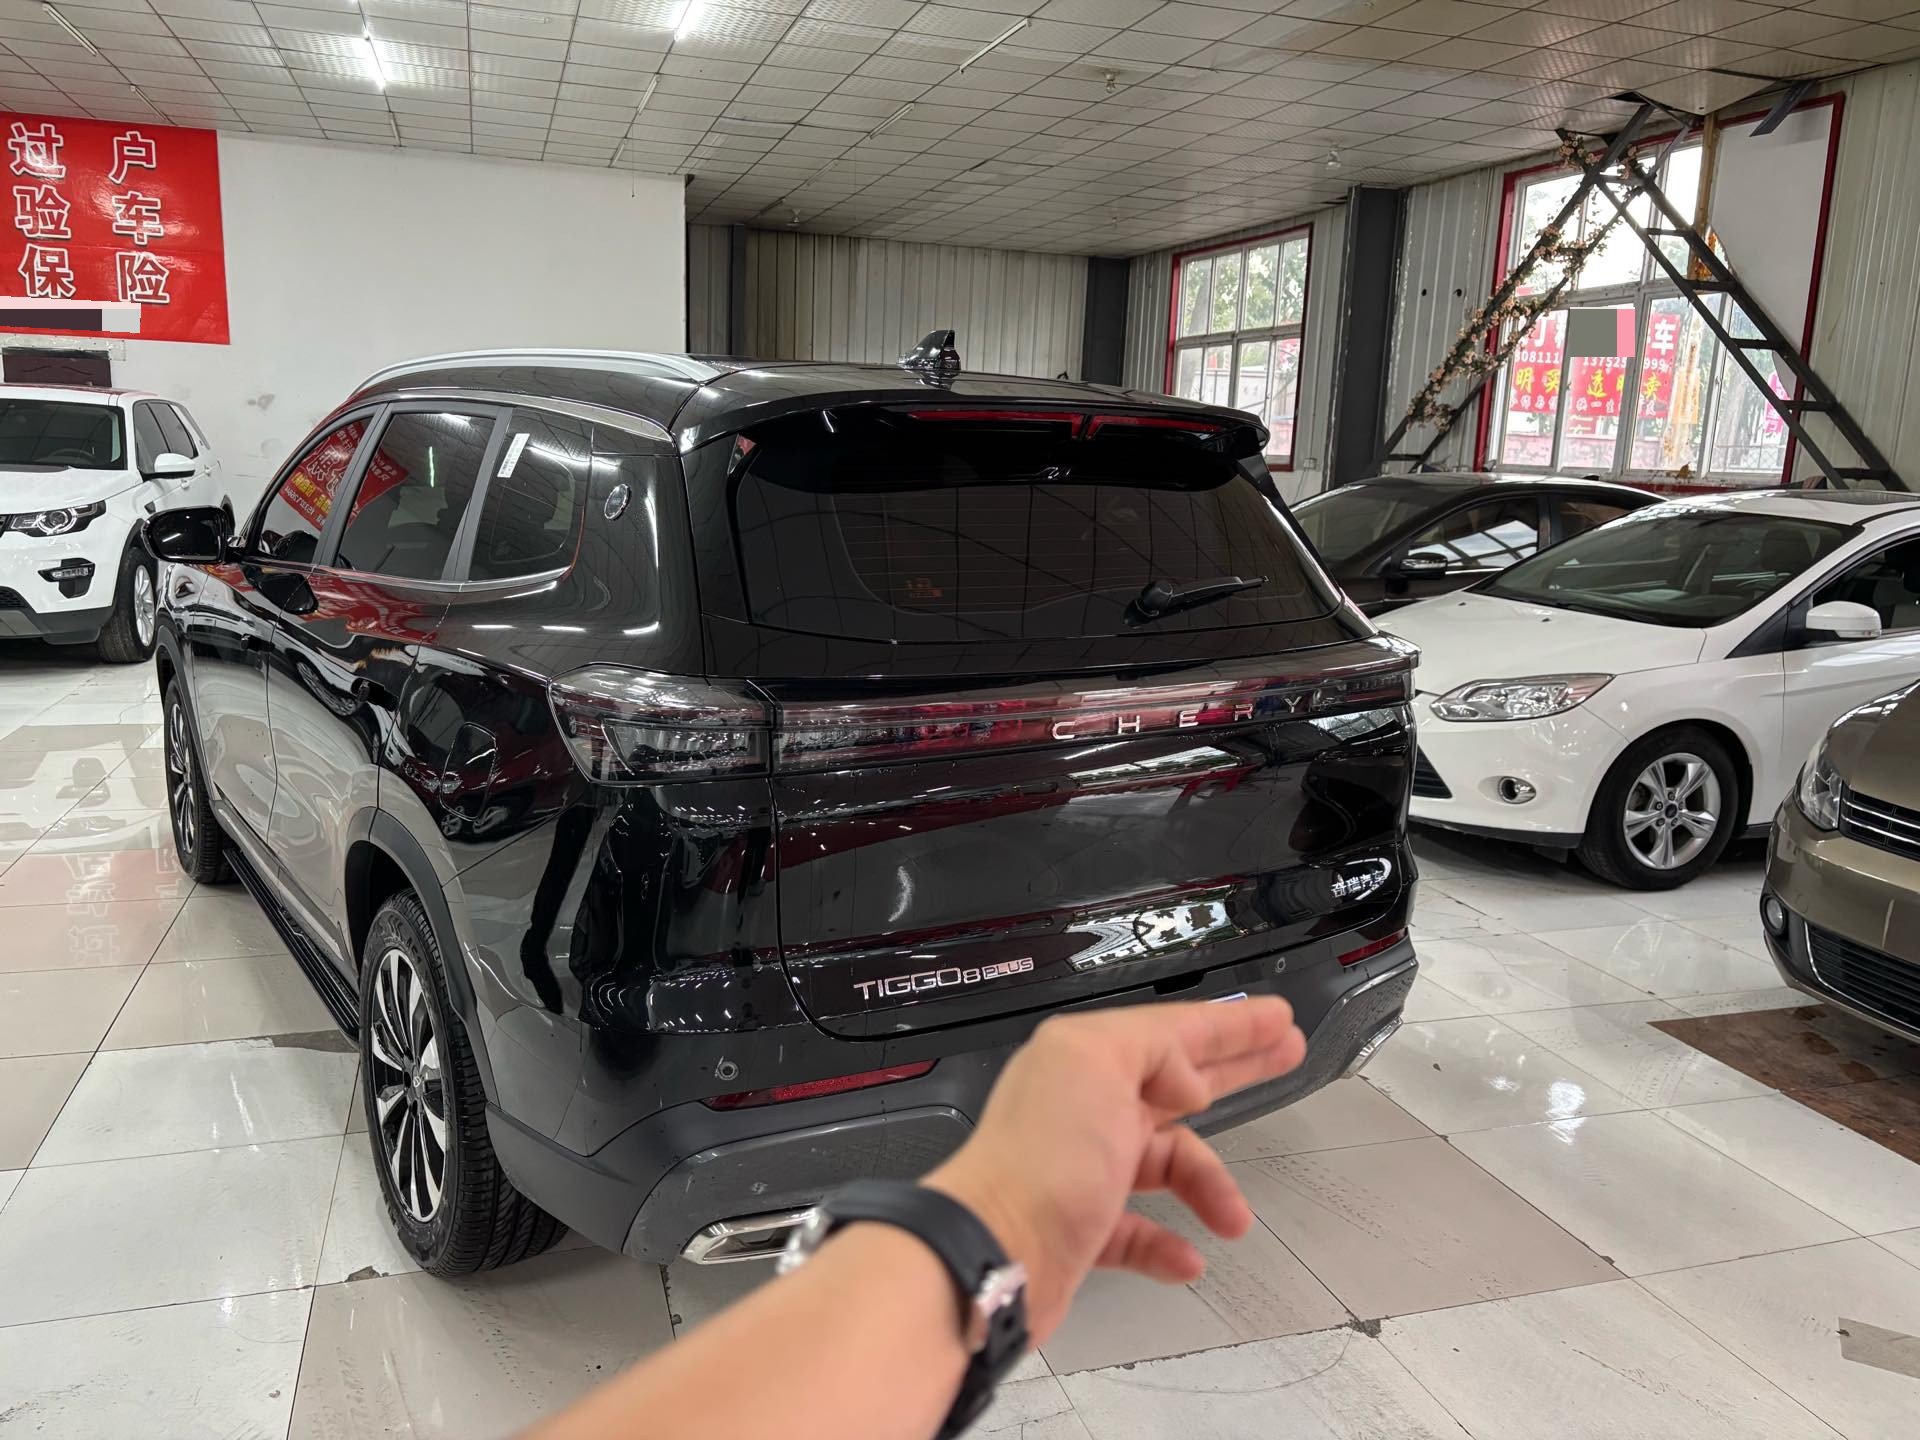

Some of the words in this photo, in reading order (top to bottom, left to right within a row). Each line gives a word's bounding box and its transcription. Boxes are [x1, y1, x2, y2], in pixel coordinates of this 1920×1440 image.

[8, 122, 156, 183] 过户
[13, 184, 164, 245] 验车
[19, 243, 171, 304] 保险
[1052, 696, 1301, 740] CHERY
[983, 957, 1034, 980] PLUS
